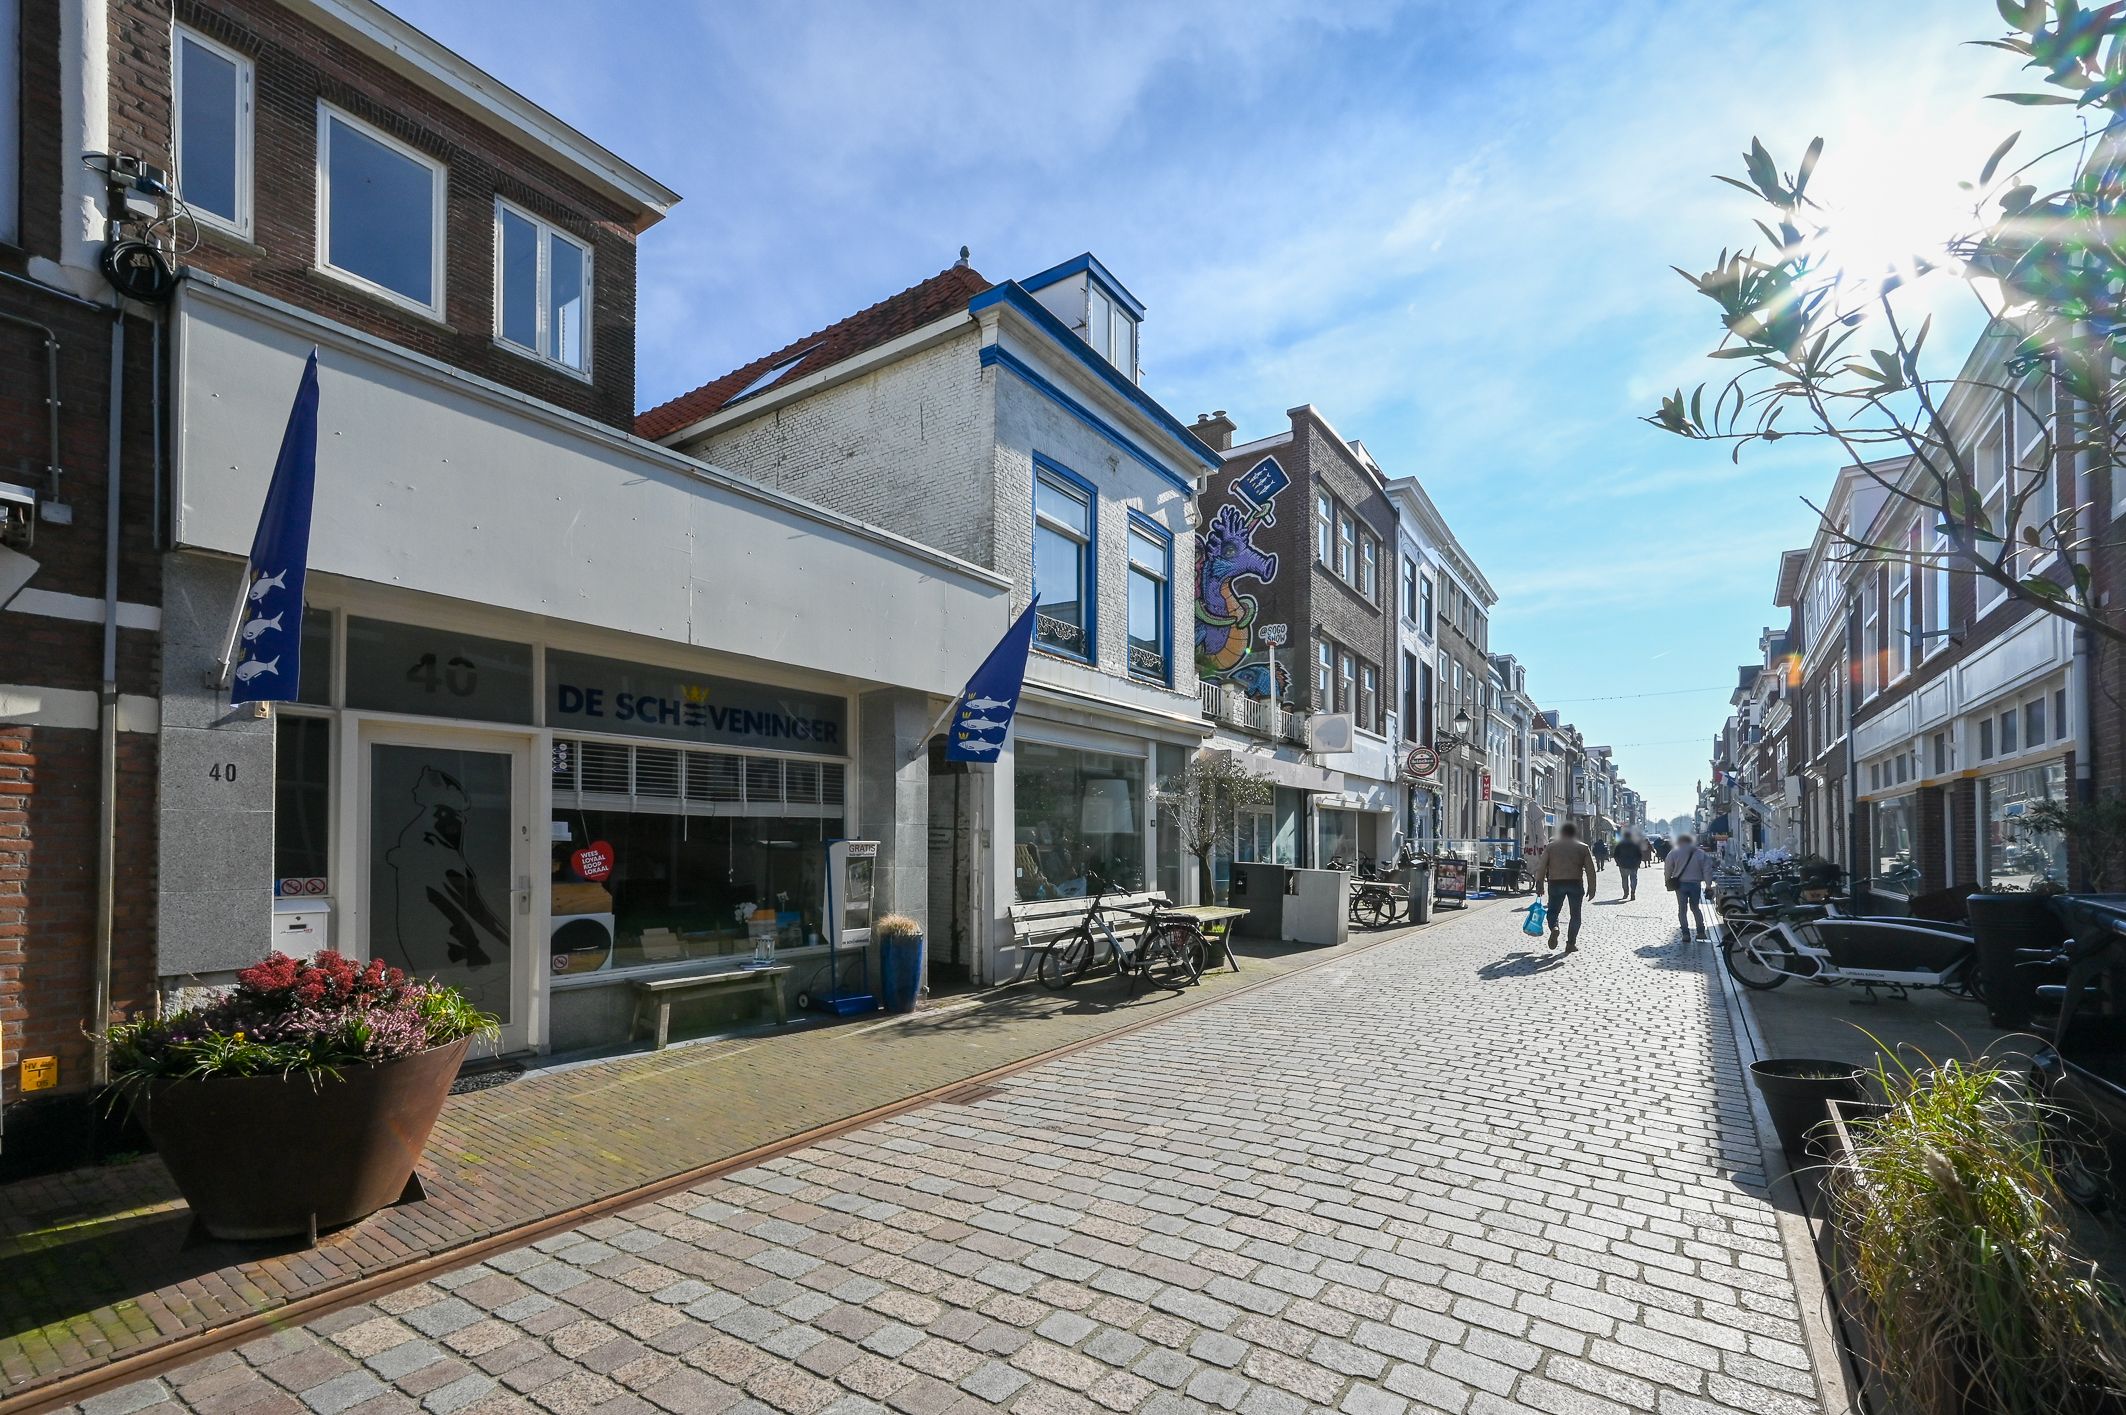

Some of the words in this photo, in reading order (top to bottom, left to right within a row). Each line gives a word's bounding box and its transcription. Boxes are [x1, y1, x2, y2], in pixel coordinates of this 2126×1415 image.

[406, 653, 478, 697] 40
[558, 684, 604, 717] DE
[209, 763, 237, 782] 40
[849, 844, 876, 853] GRATIS
[580, 850, 598, 858] WEES
[582, 854, 606, 864] LOYAAL
[583, 861, 602, 870] KOOP
[584, 865, 609, 876] LOKAAL
